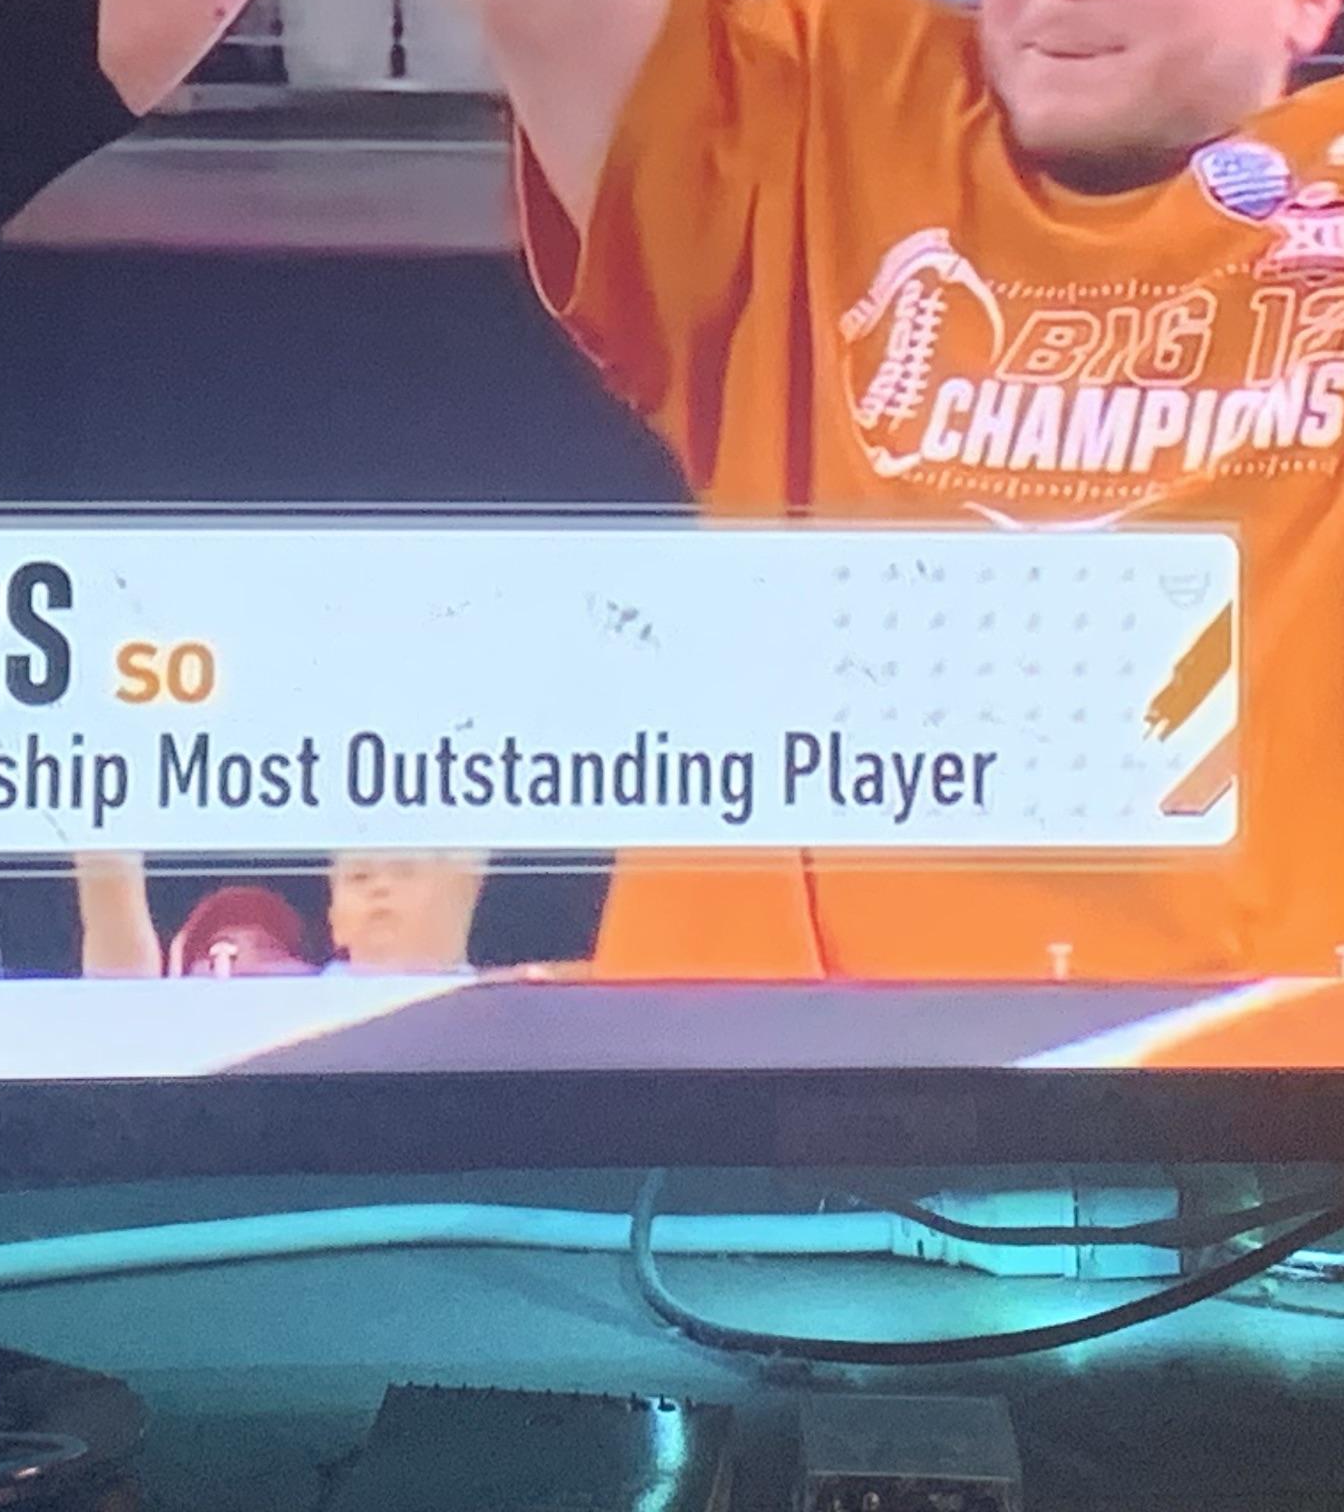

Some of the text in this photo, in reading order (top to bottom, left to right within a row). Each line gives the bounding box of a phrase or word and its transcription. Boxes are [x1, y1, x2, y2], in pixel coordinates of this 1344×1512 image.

[994, 287, 1217, 387] BIG
[158, 731, 318, 809] Most
[346, 729, 755, 825] Outstanding
[783, 730, 998, 823] Player
